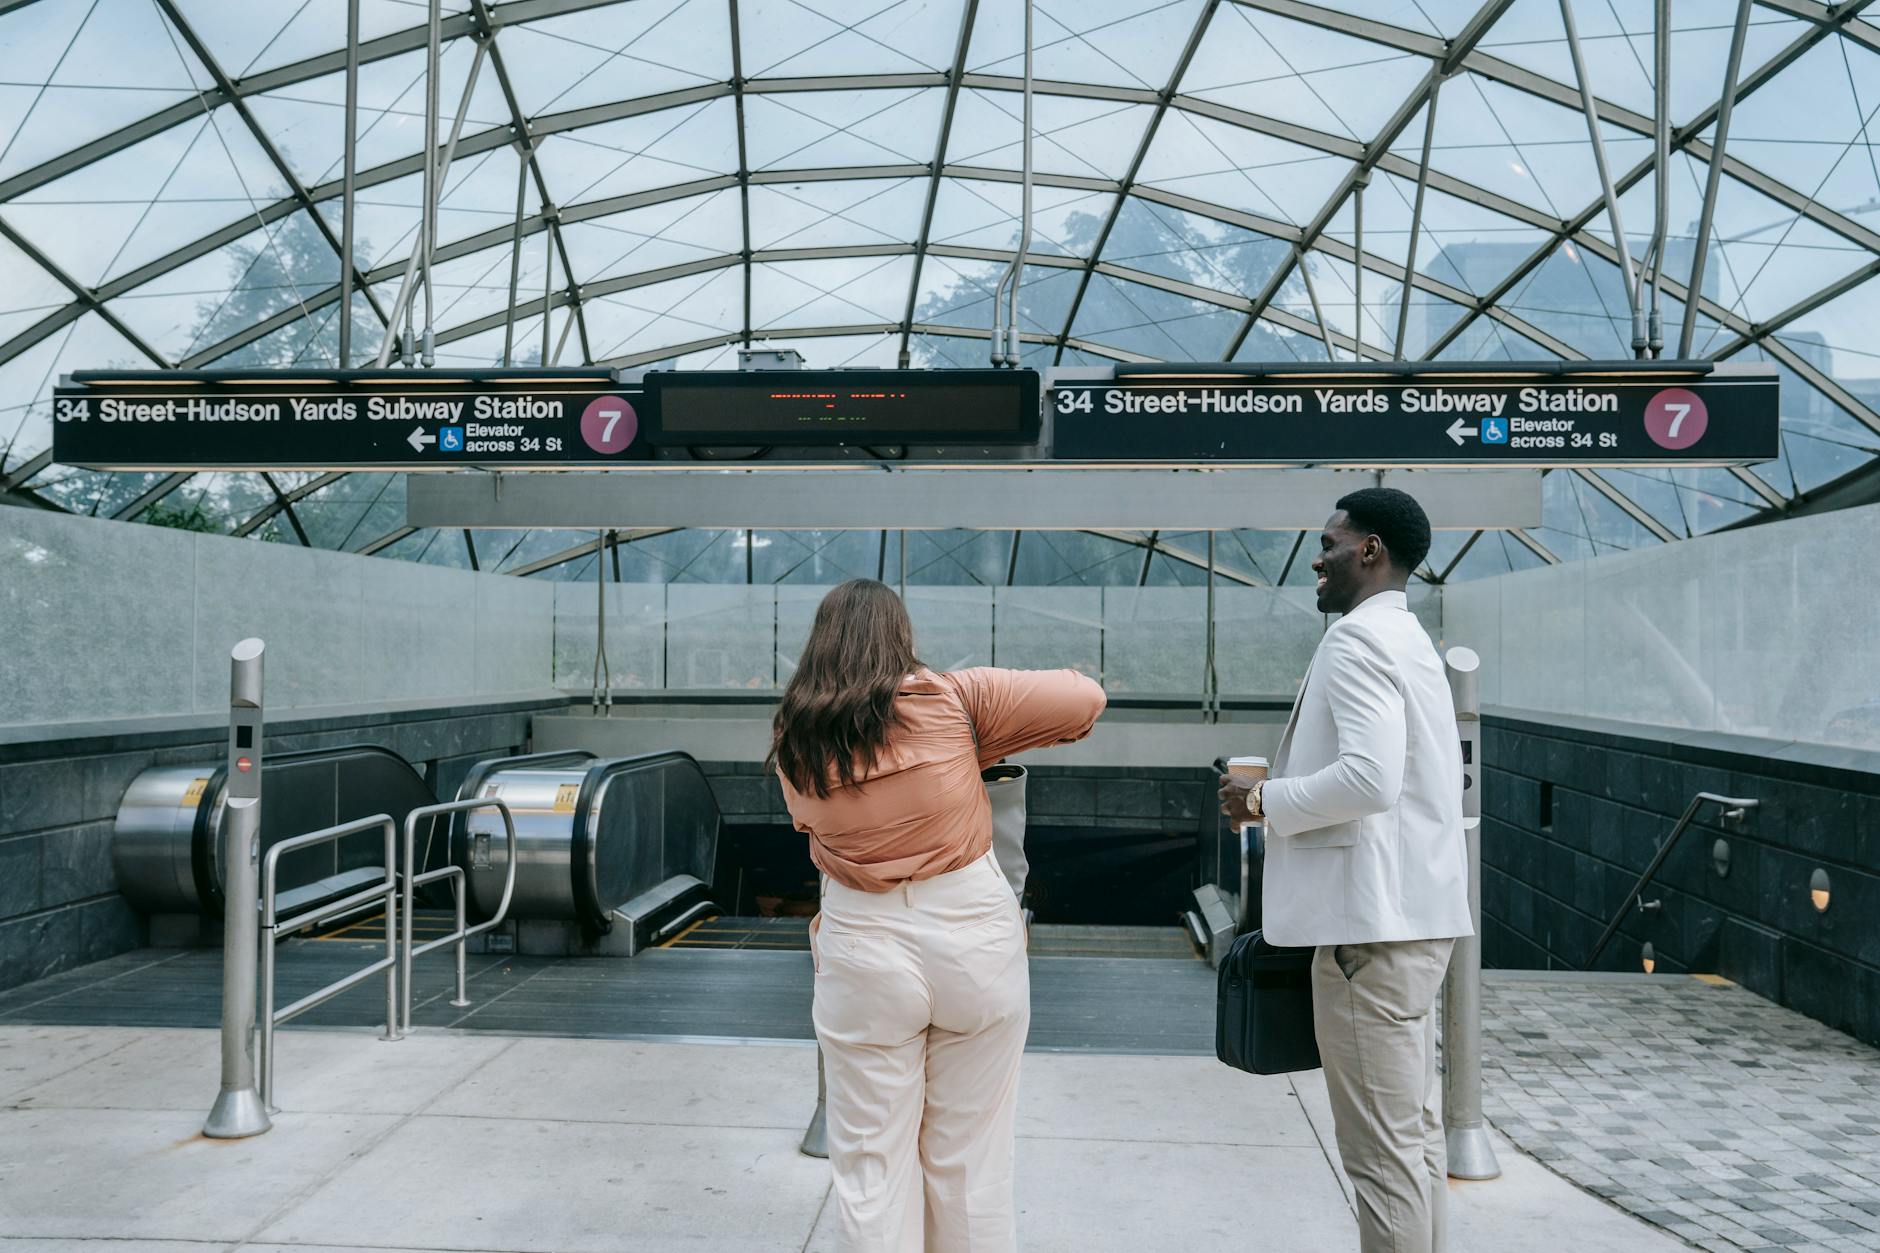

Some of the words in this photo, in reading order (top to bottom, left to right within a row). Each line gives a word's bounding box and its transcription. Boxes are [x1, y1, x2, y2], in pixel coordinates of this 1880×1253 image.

[56, 399, 91, 422] 34
[99, 398, 280, 422] Street-Hudson
[289, 398, 357, 421] Yards
[367, 397, 464, 424] Subway
[473, 395, 563, 420] Station
[1057, 390, 1094, 414] 34
[1104, 390, 1303, 414] Street-Hudson
[1314, 389, 1389, 413] Yards
[1400, 388, 1508, 416] Subway
[1518, 387, 1619, 413] Station
[466, 423, 524, 437] Elevator
[598, 411, 621, 442] 7
[1510, 417, 1575, 432] Elevator
[1665, 404, 1691, 437] 7
[465, 440, 515, 452] across
[520, 437, 541, 452] 34
[545, 437, 563, 452] St
[1510, 436, 1565, 449] across
[1570, 434, 1593, 449] 34
[1598, 434, 1618, 449] St
